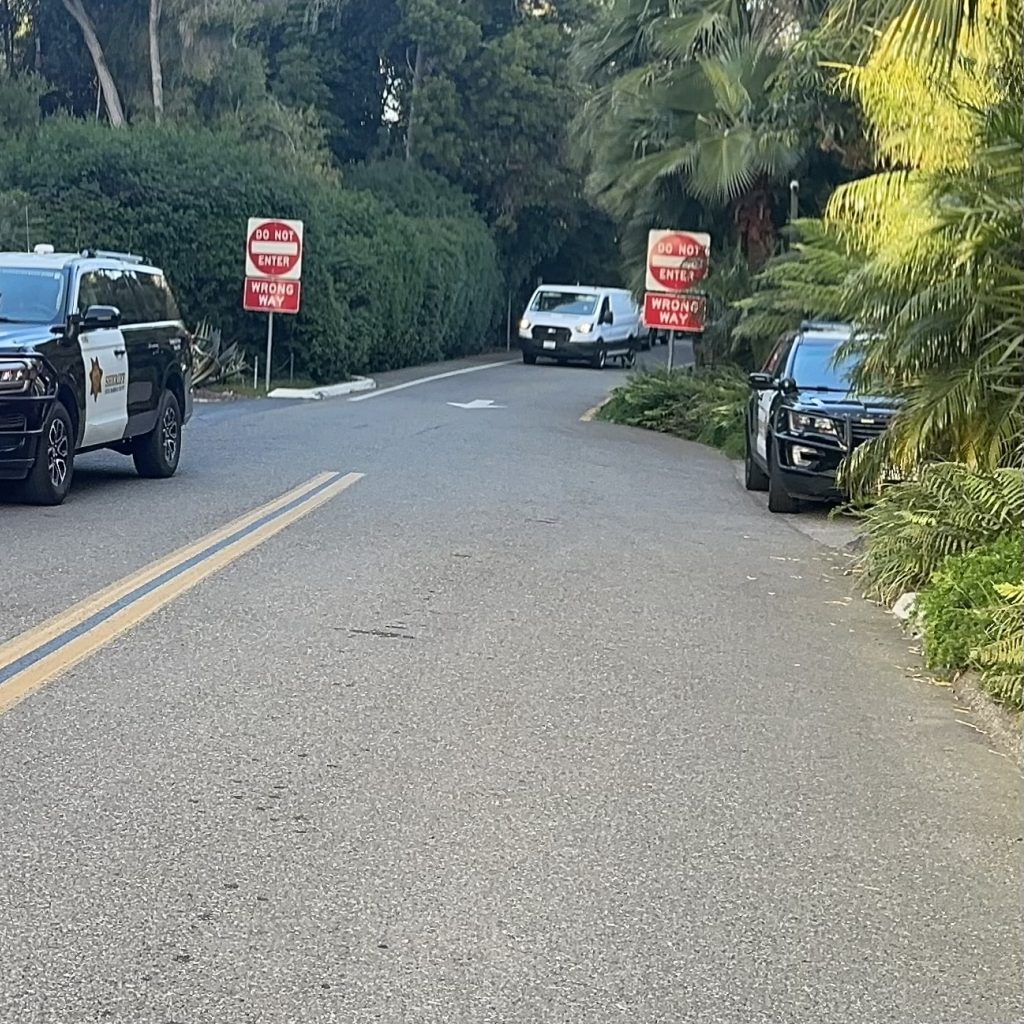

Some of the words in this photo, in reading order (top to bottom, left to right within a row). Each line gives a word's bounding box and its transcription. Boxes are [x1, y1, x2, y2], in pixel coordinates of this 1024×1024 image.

[256, 229, 269, 240] DO
[275, 230, 294, 241] NOT
[657, 242, 673, 254] DO
[258, 255, 290, 267] ENTER
[251, 281, 294, 295] WRONG
[258, 294, 285, 307] WAY
[651, 297, 699, 313] WRONG
[659, 311, 689, 325] WAY
